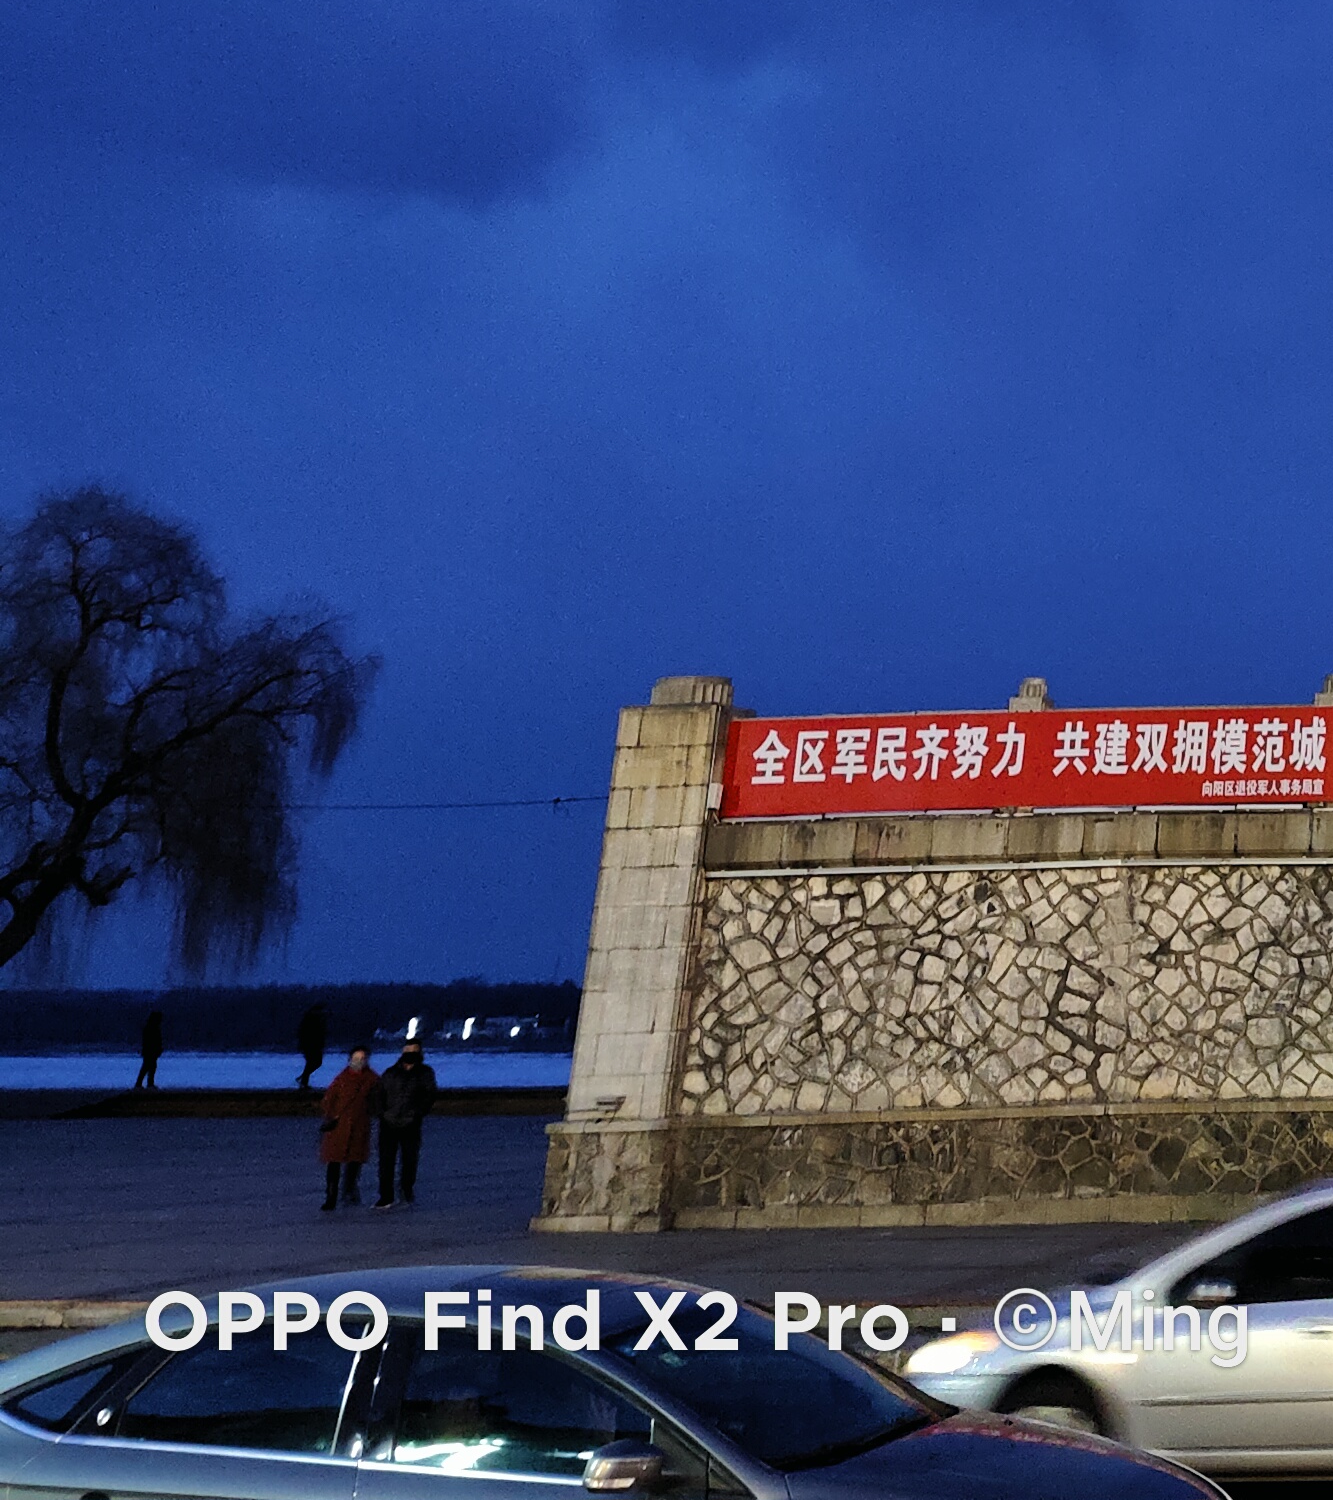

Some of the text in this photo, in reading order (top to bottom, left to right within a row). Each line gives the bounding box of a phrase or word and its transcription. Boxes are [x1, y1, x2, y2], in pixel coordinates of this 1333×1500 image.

[751, 716, 1327, 785] 全区军民齐努力 共建双拥模范城
[1202, 779, 1325, 797] 向阳区退役军人事务局宣
